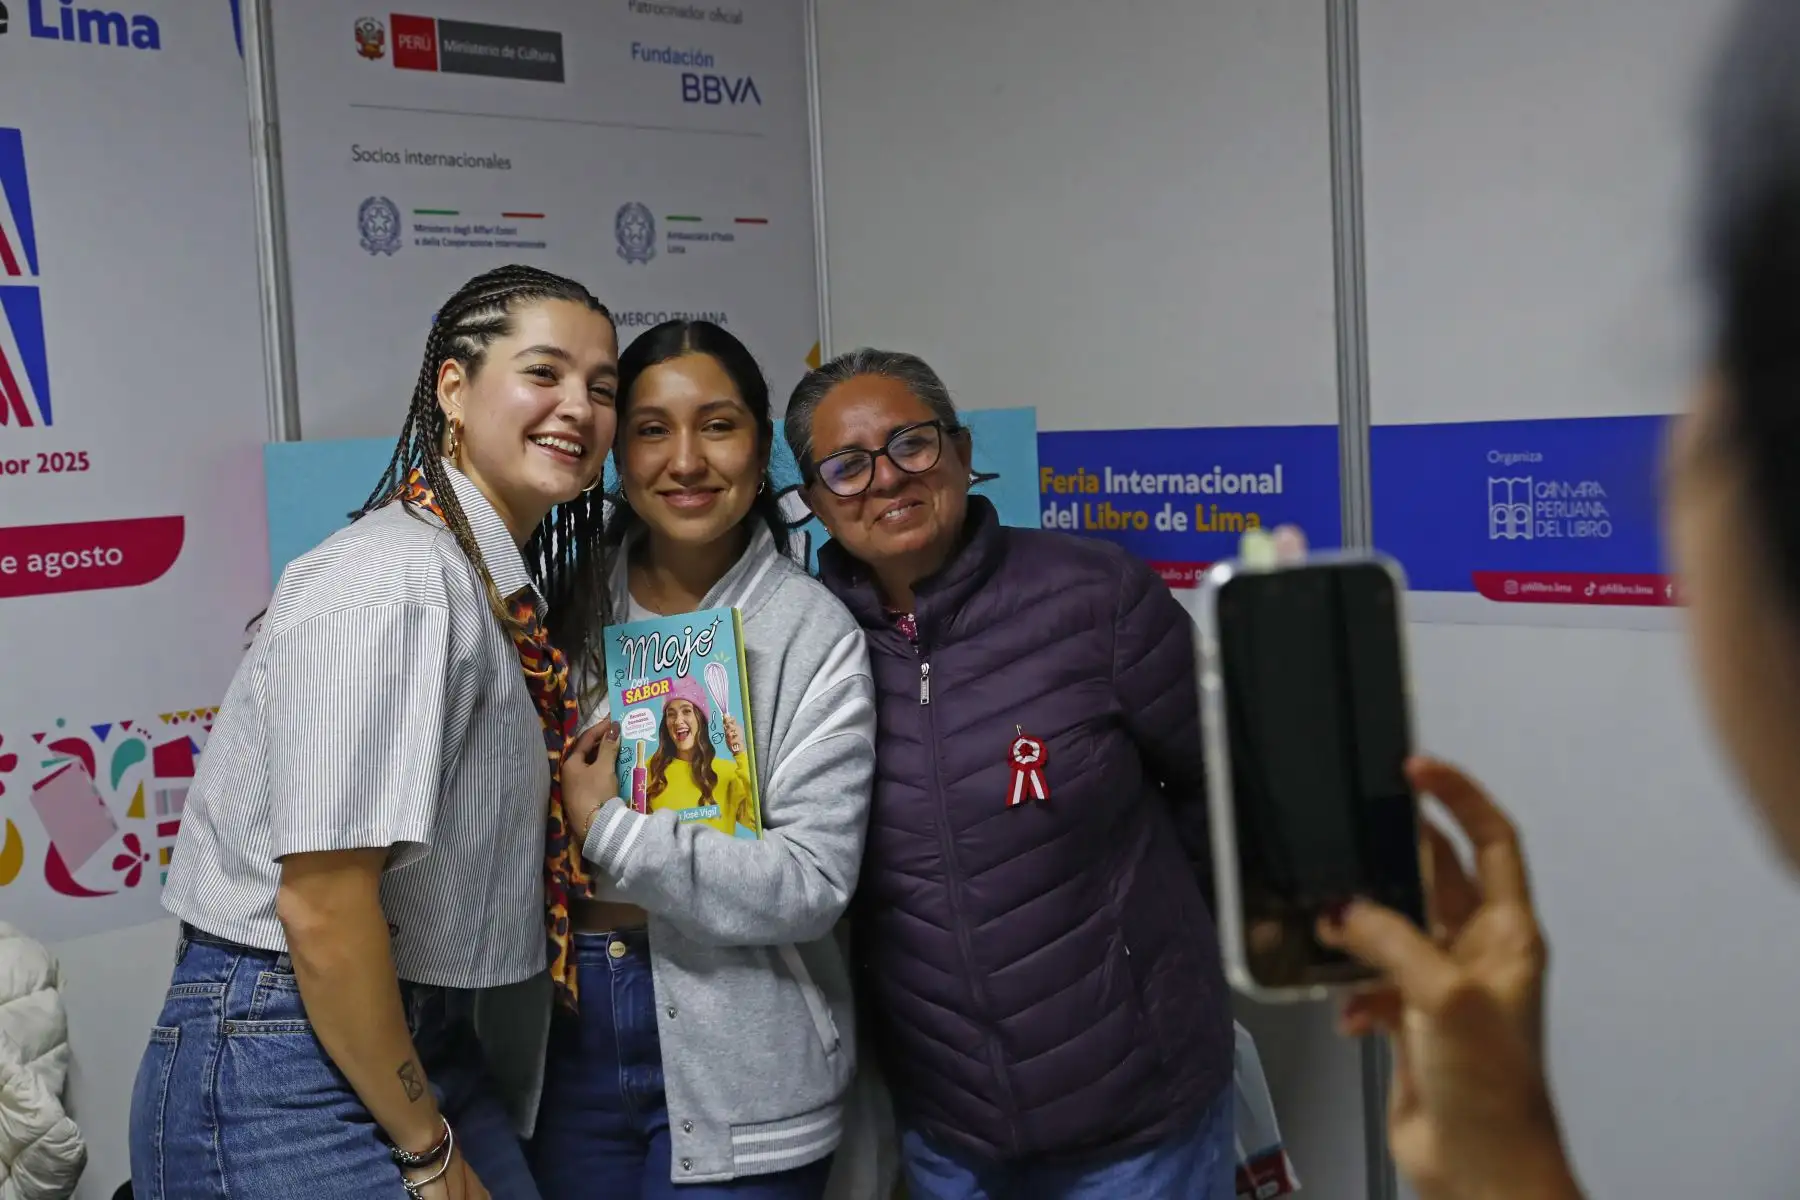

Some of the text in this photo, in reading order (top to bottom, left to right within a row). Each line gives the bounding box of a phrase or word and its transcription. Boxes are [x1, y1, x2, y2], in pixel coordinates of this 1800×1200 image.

[629, 0, 744, 24] Patrocinador oficial
[28, 0, 161, 50] Lima
[399, 33, 432, 50] PERÚ
[444, 39, 557, 63] Ministerio de Cultura
[632, 42, 714, 67] Fundación
[682, 73, 762, 106] BBVA
[352, 145, 512, 170] Socios internacionales
[37, 451, 90, 473] 2025
[1487, 449, 1543, 466] Organiza
[1040, 464, 1282, 494] Feria Internacional
[1041, 501, 1260, 533] del Libro de Lima
[1535, 500, 1610, 519] PERUANA
[1535, 519, 1613, 539] DEL LIBRO
[27, 546, 123, 578] agosto
[621, 623, 717, 681] Majo
[625, 680, 670, 704] SABOR
[630, 677, 650, 690] con
[700, 806, 718, 818] Vigil
